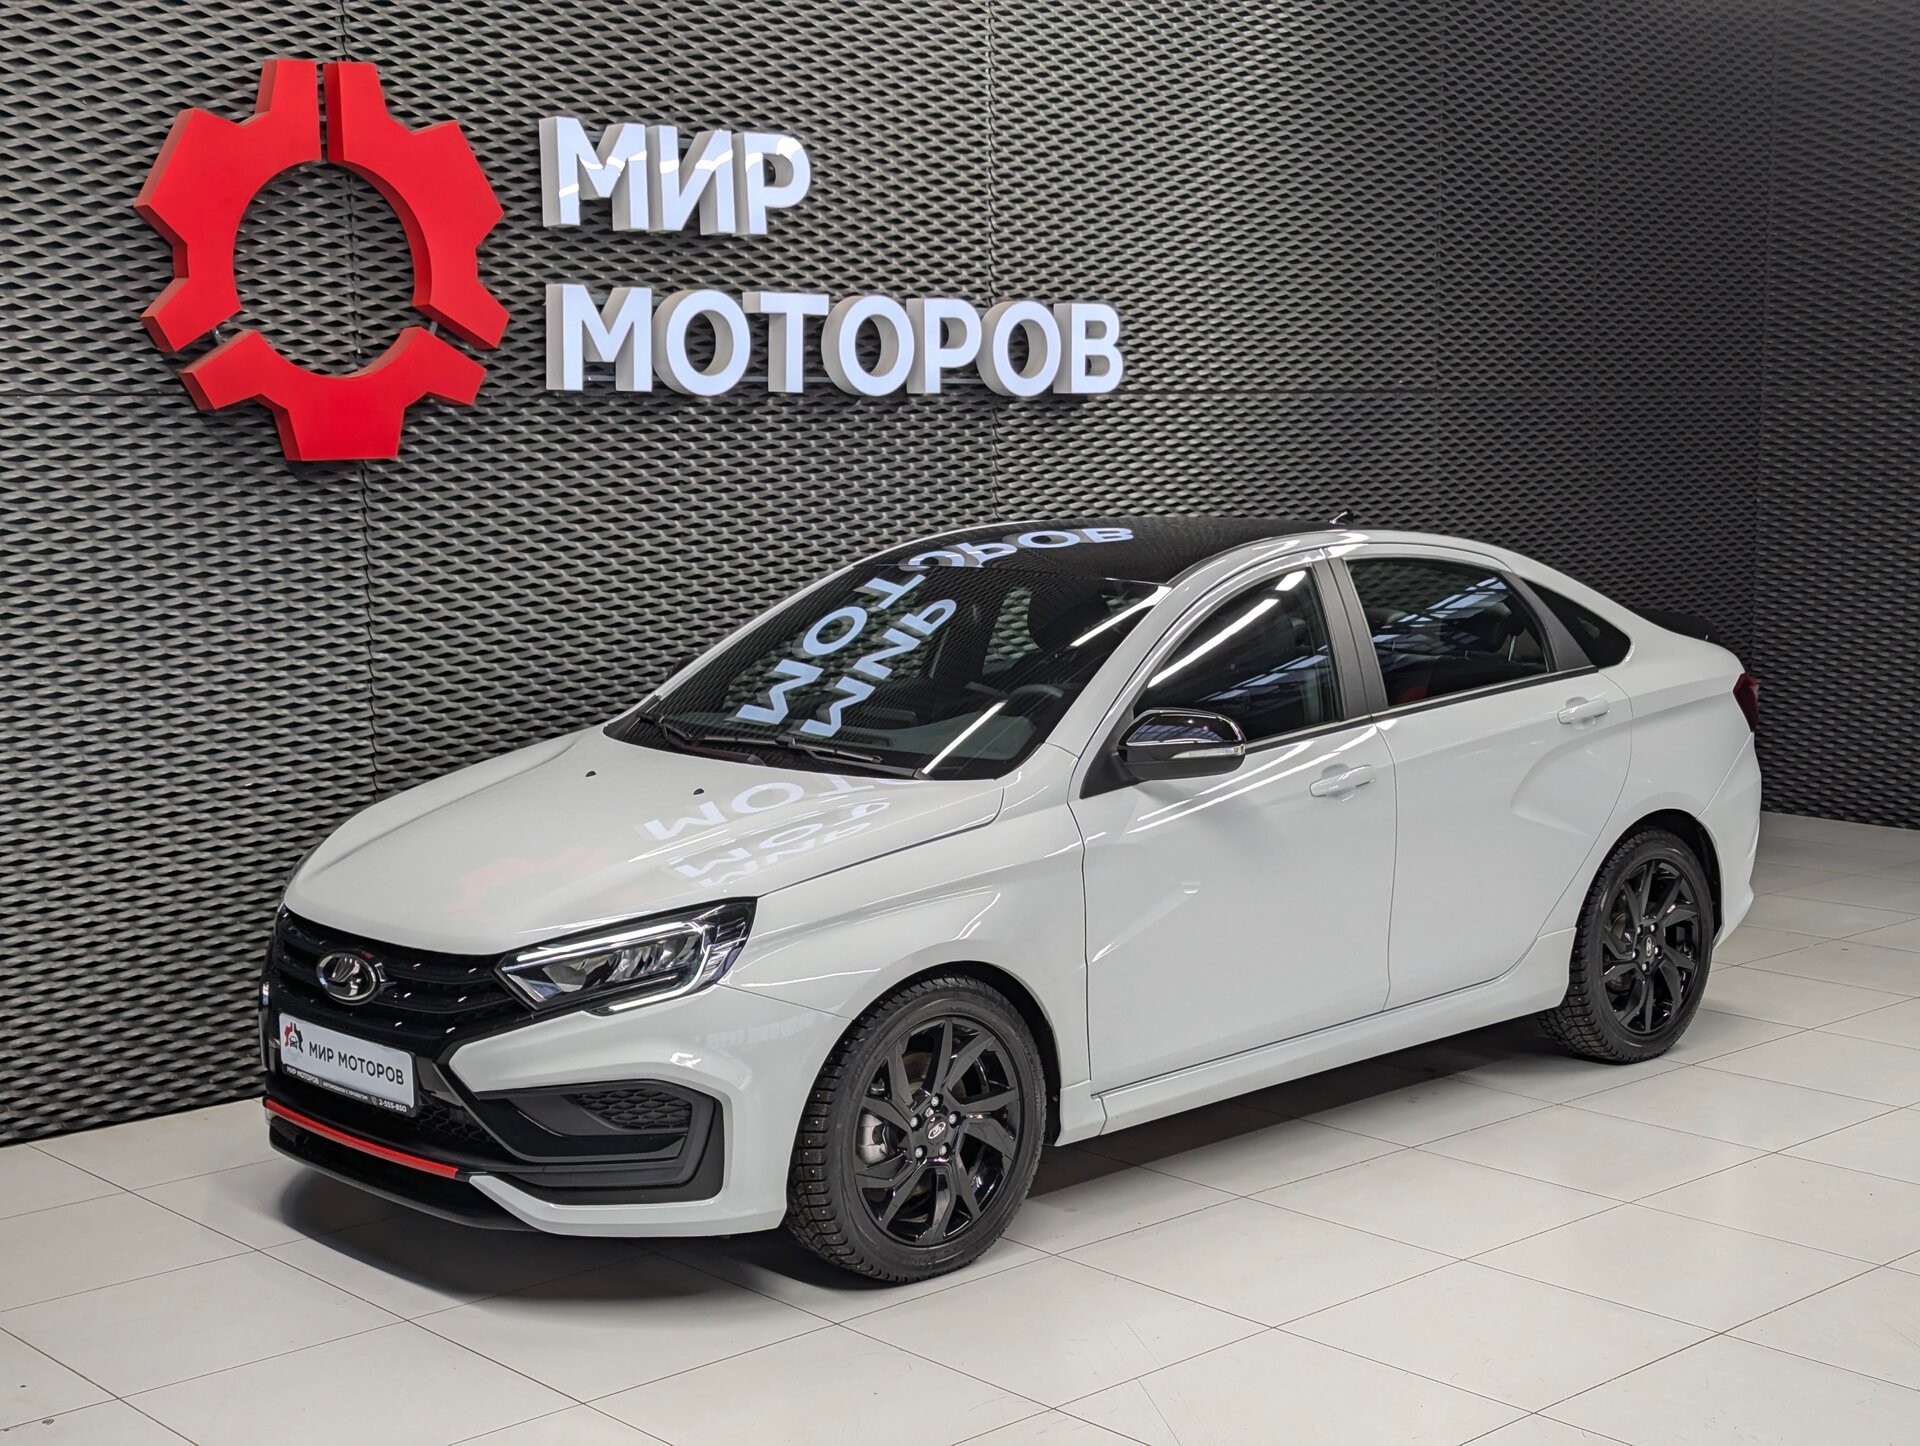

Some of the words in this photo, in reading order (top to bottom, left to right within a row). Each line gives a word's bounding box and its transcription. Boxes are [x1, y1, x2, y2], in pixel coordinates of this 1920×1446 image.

[539, 116, 811, 236] МИР
[545, 283, 1124, 397] МОТОРОВ
[309, 1041, 334, 1063] МИР
[338, 1051, 404, 1086] МОТОРОВ
